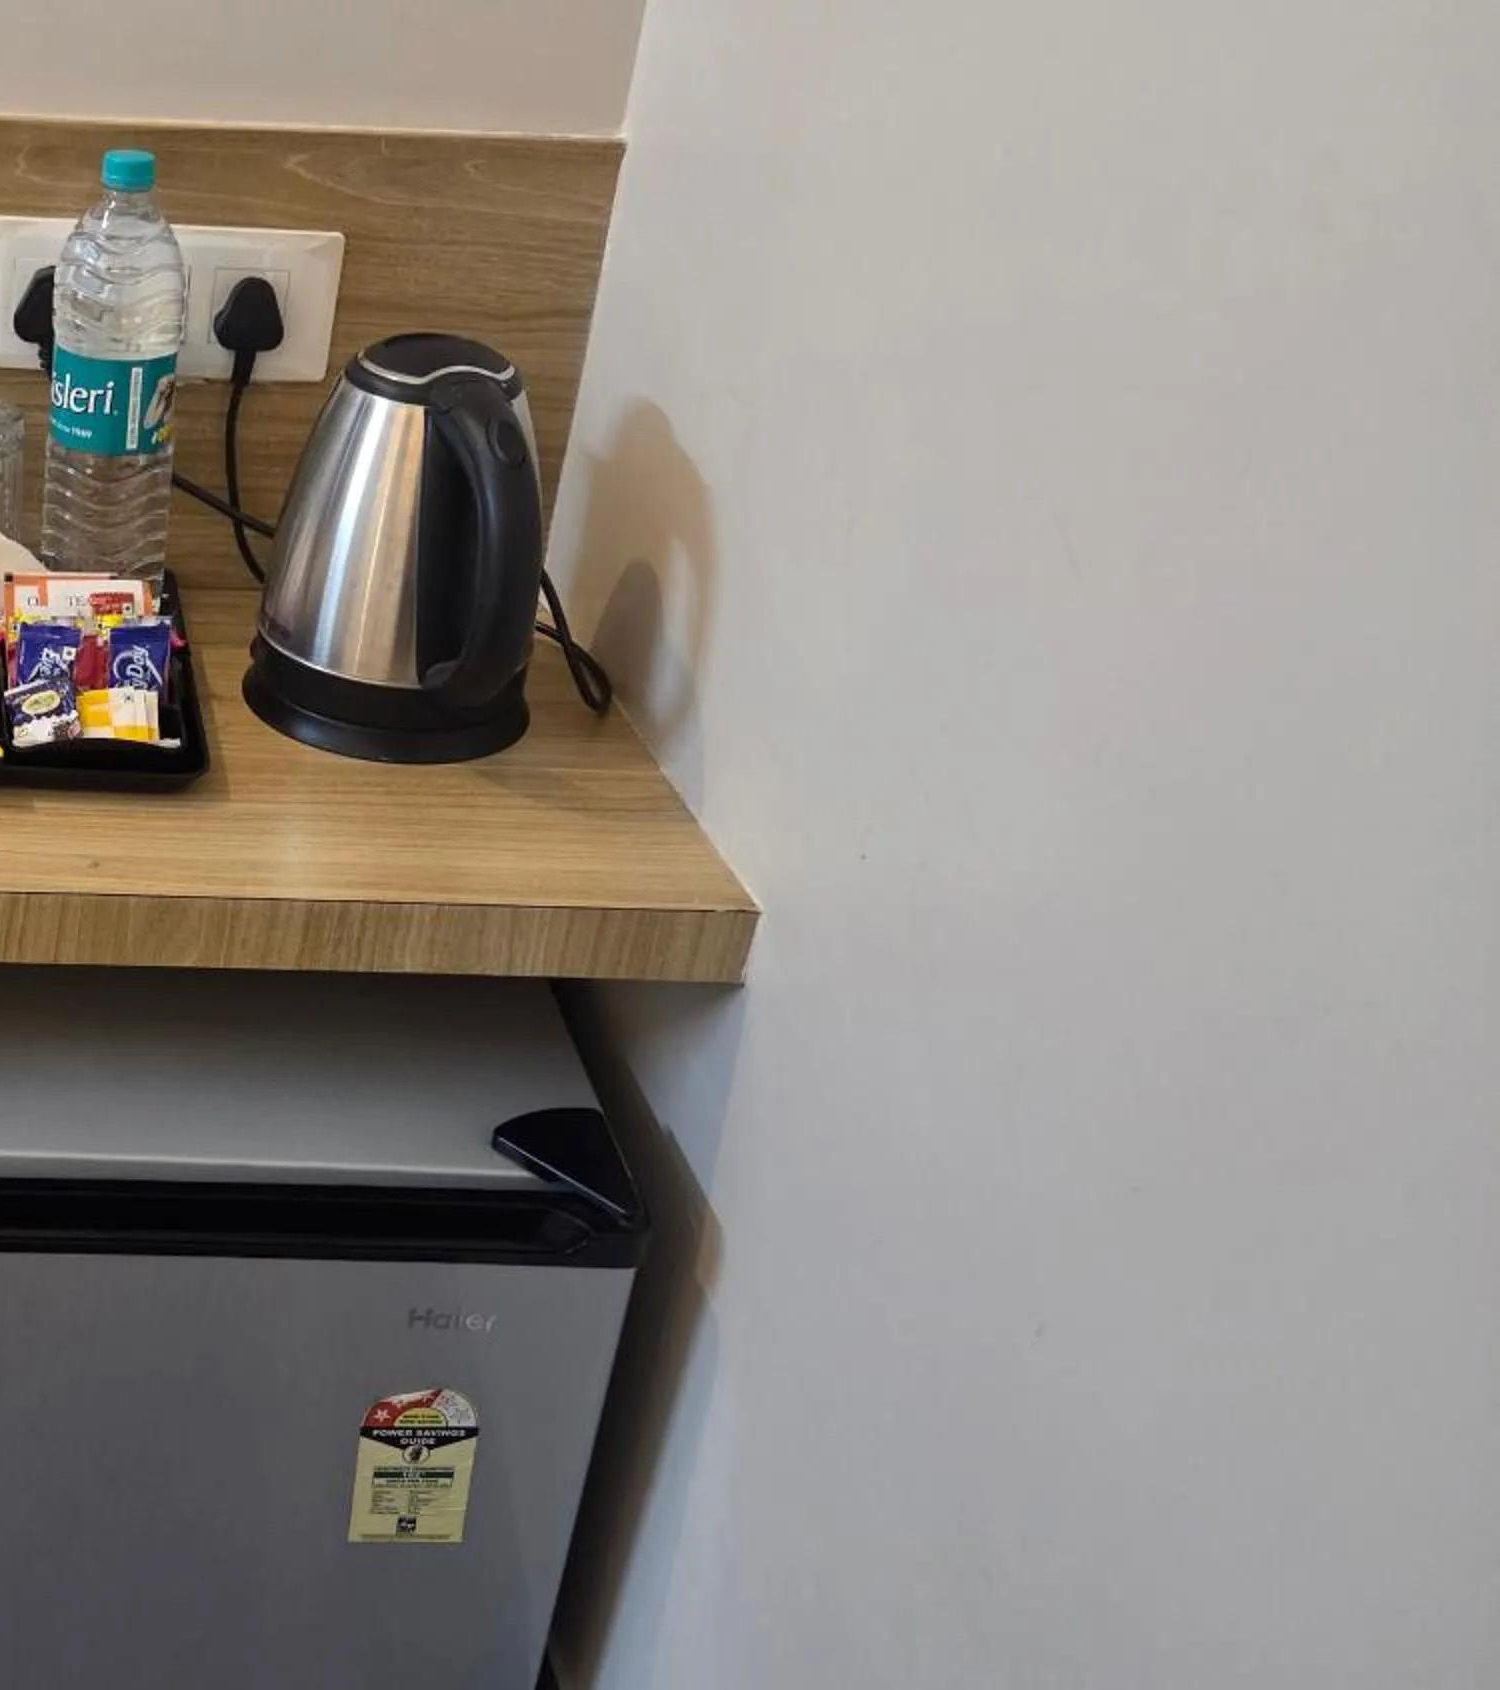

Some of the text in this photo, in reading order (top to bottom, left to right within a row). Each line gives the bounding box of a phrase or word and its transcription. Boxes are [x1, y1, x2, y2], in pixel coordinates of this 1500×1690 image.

[51, 371, 115, 415] isleri
[407, 1308, 497, 1332] Haier
[372, 1429, 466, 1437] POWER SAVINGS
[400, 1437, 436, 1445] GUIDE
